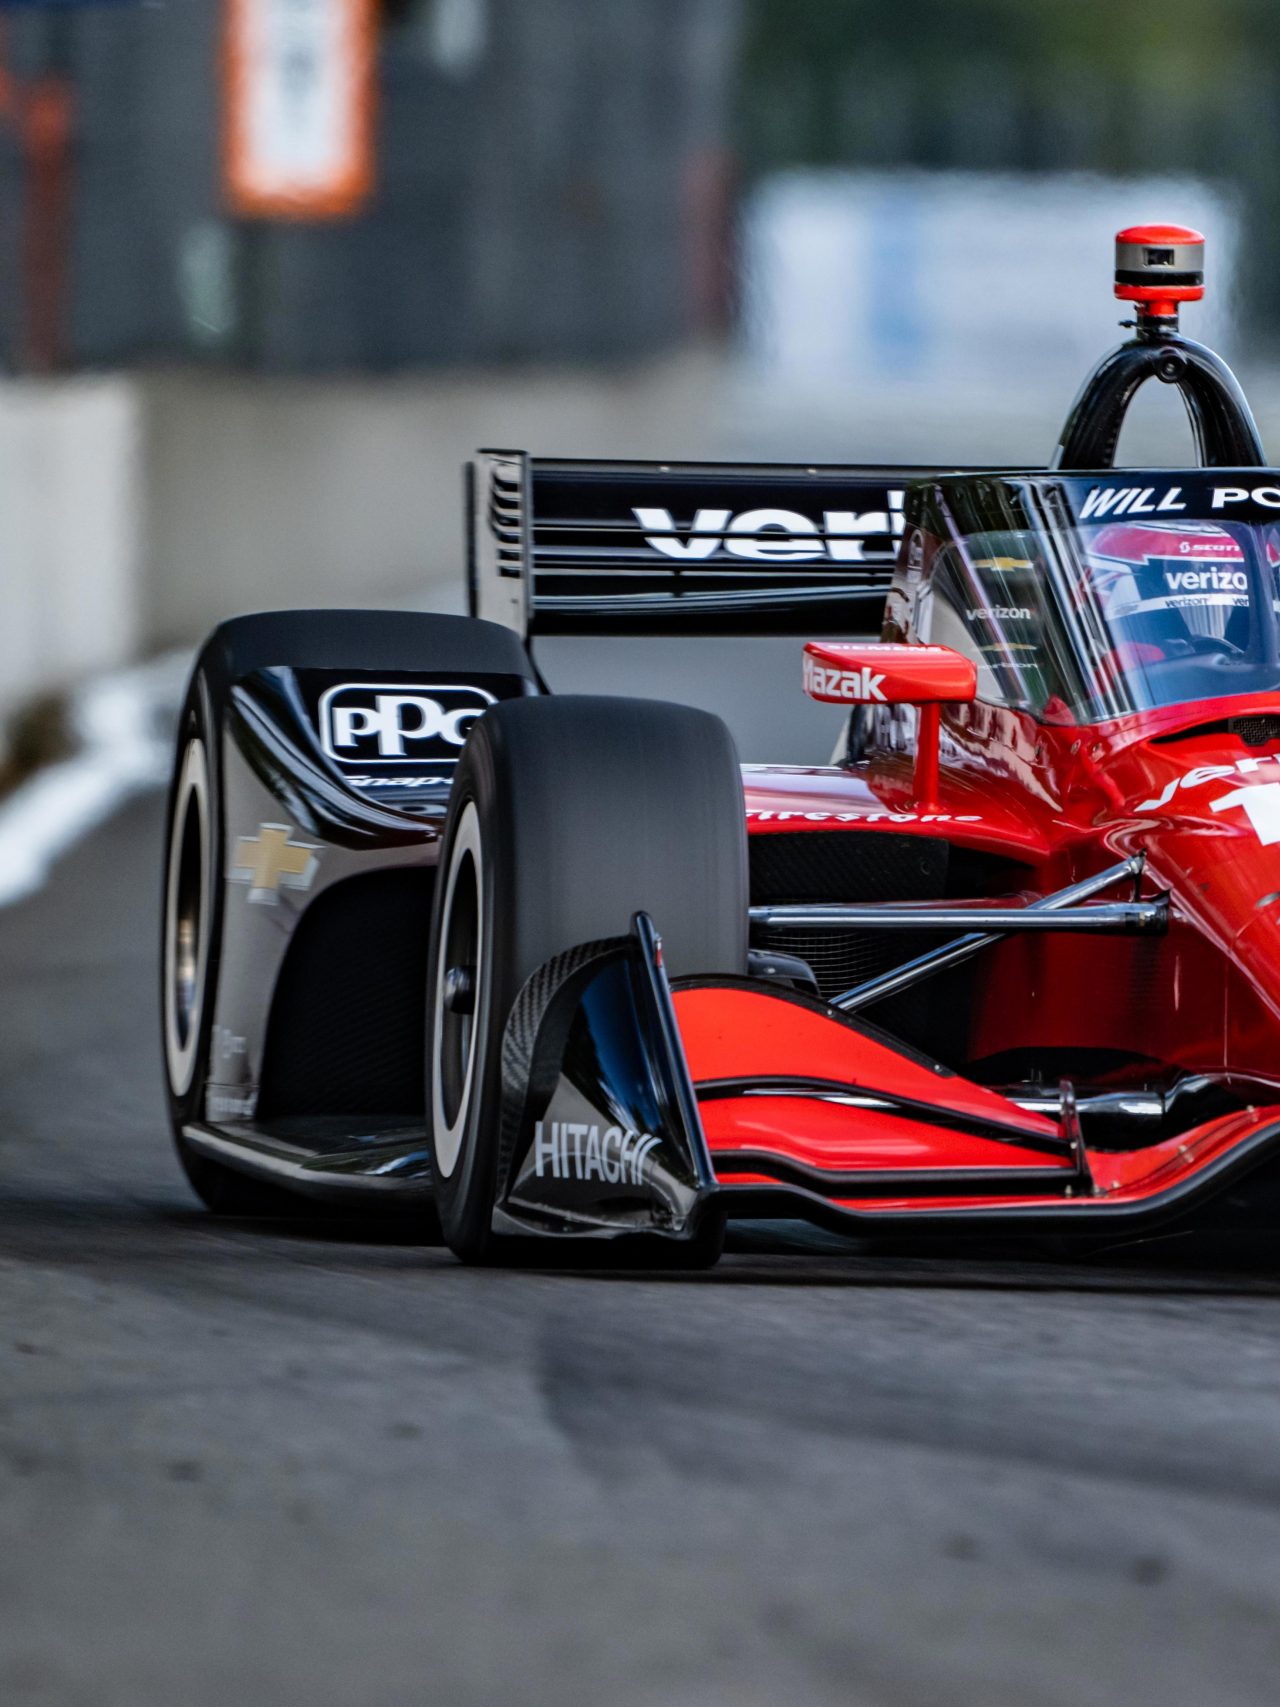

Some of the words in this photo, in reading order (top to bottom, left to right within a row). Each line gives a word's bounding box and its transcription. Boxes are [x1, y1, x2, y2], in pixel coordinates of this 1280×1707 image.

[1080, 487, 1186, 518] WILL
[966, 605, 1031, 620] verizon
[535, 1121, 663, 1186] HITACHI
